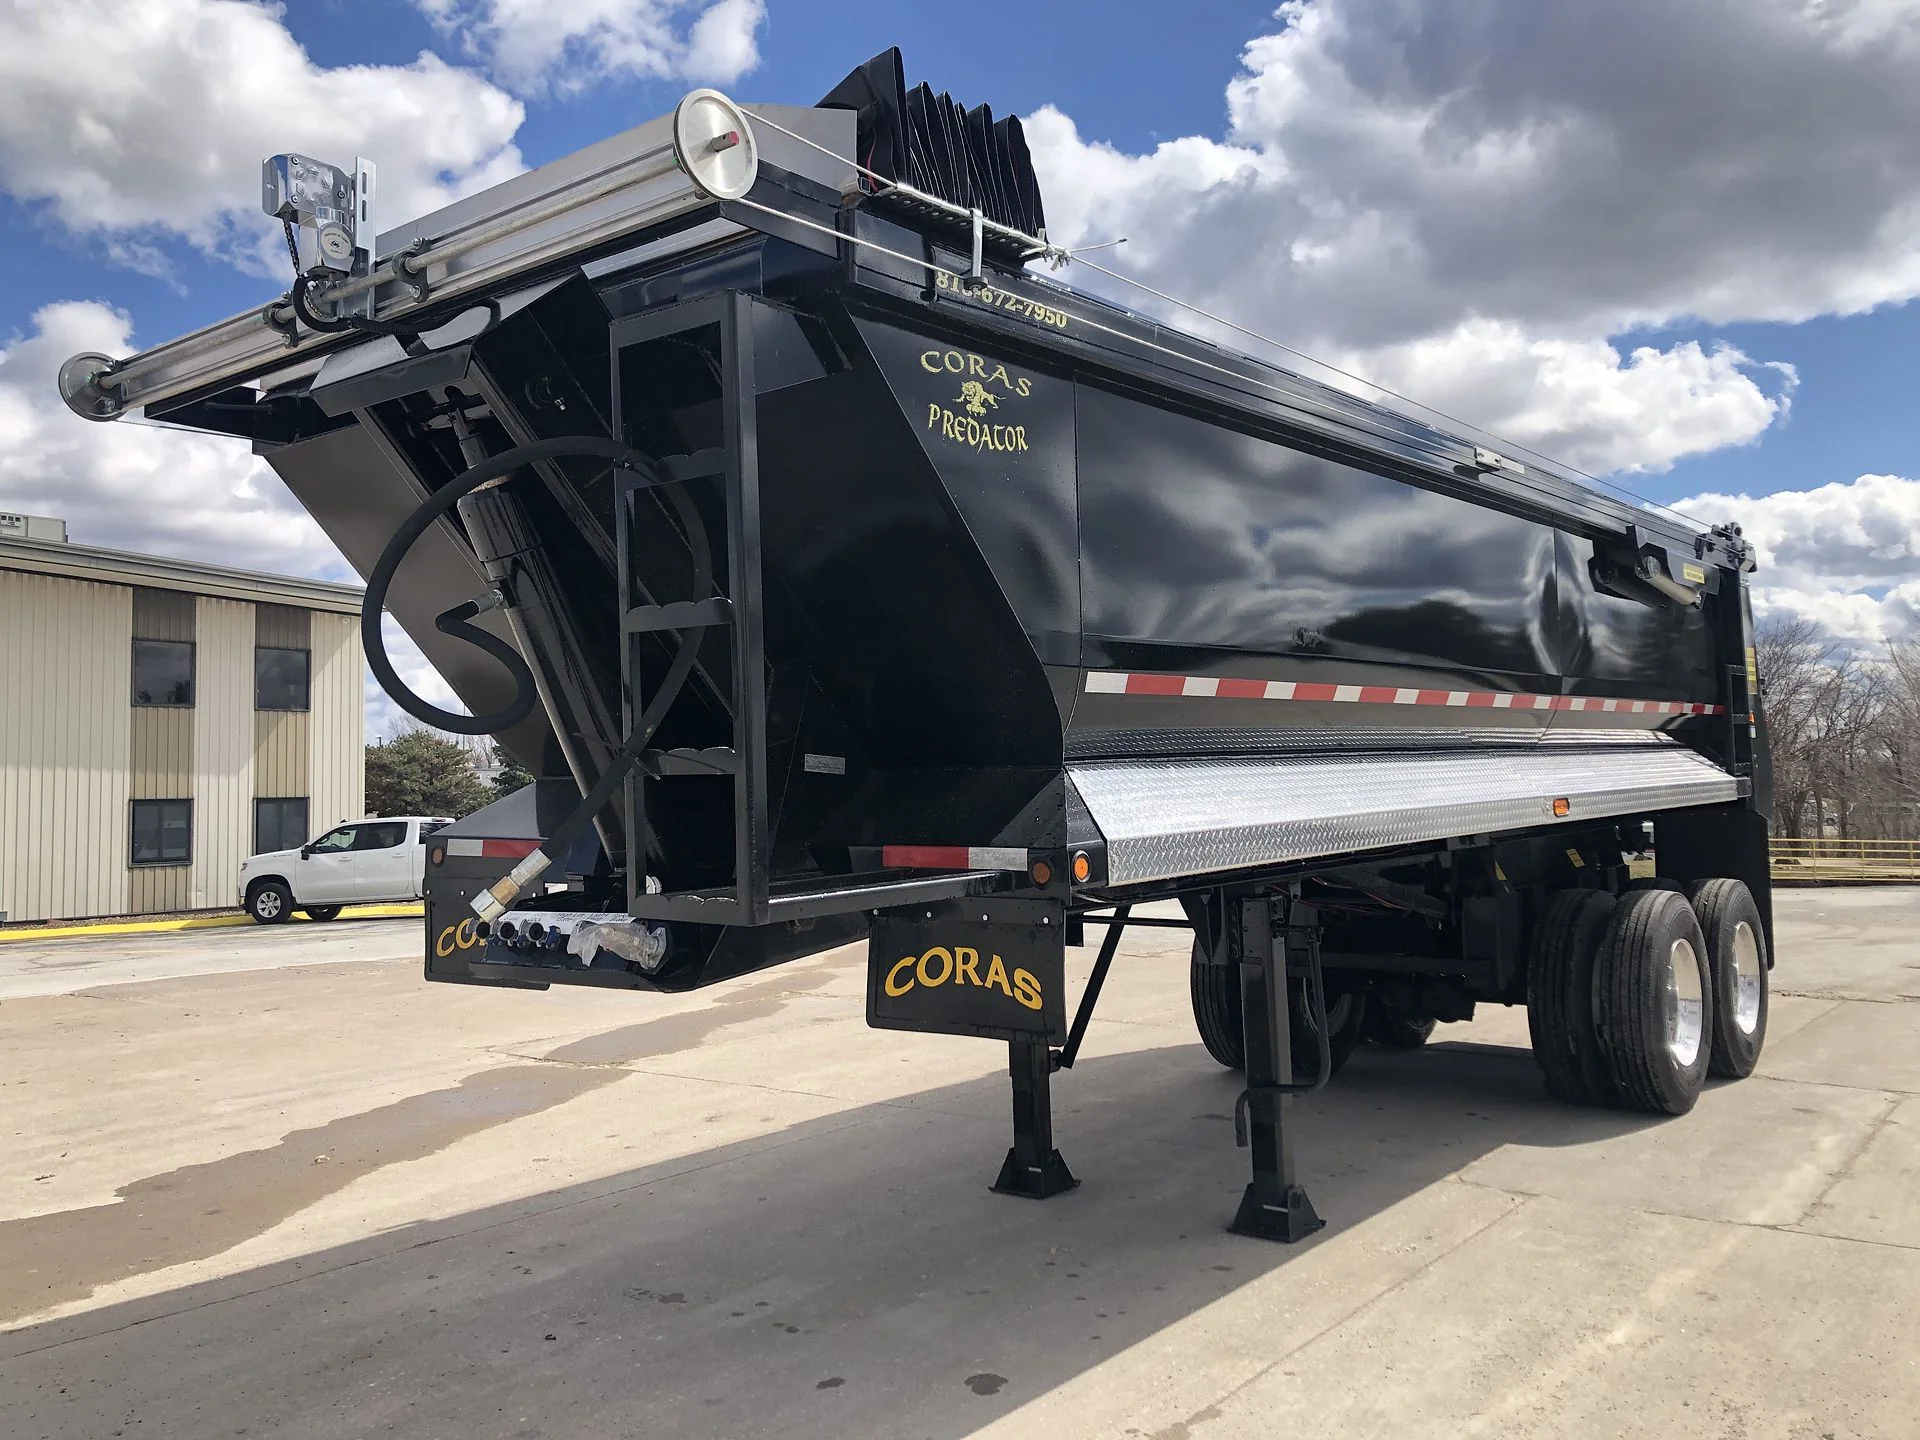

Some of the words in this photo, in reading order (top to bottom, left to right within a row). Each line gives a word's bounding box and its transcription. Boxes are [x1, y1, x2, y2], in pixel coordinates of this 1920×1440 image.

[920, 350, 1033, 397] CORAS
[928, 403, 1029, 454] PREDATOR
[884, 946, 1043, 1010] CORAS
